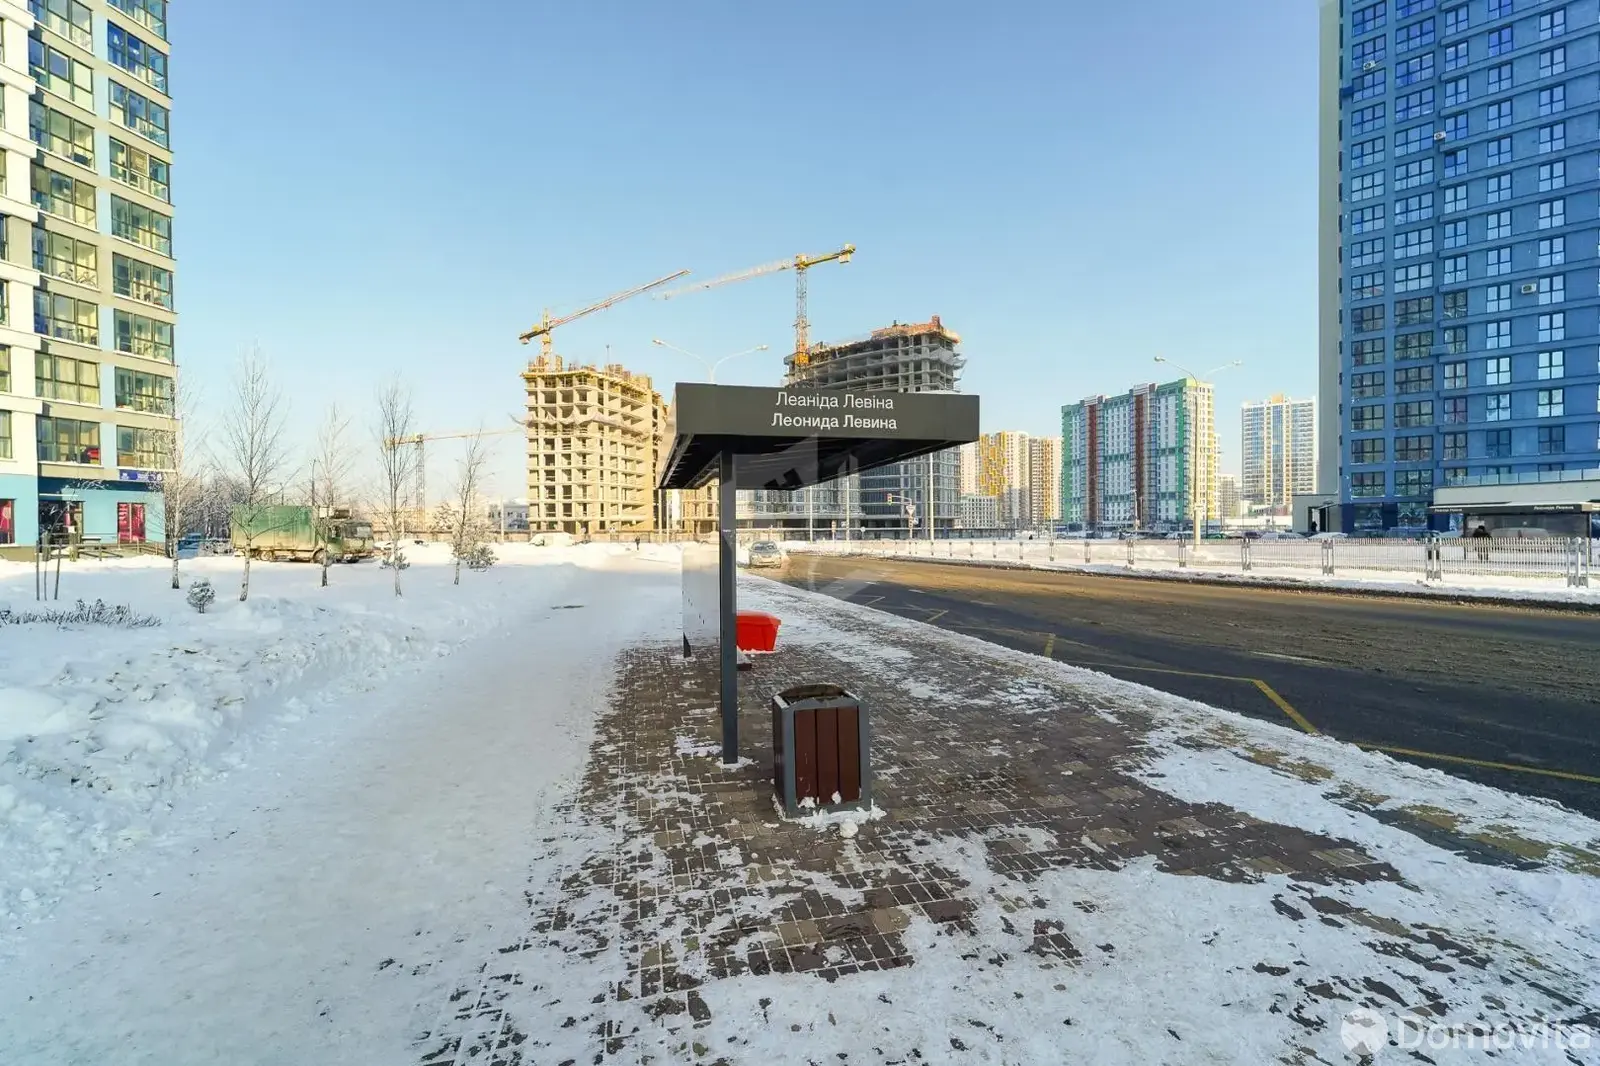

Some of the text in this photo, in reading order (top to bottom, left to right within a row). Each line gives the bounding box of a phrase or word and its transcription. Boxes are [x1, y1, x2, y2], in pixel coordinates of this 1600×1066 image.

[775, 392, 894, 410] Леаніда Левіна
[771, 412, 898, 430] Леонида Левина
